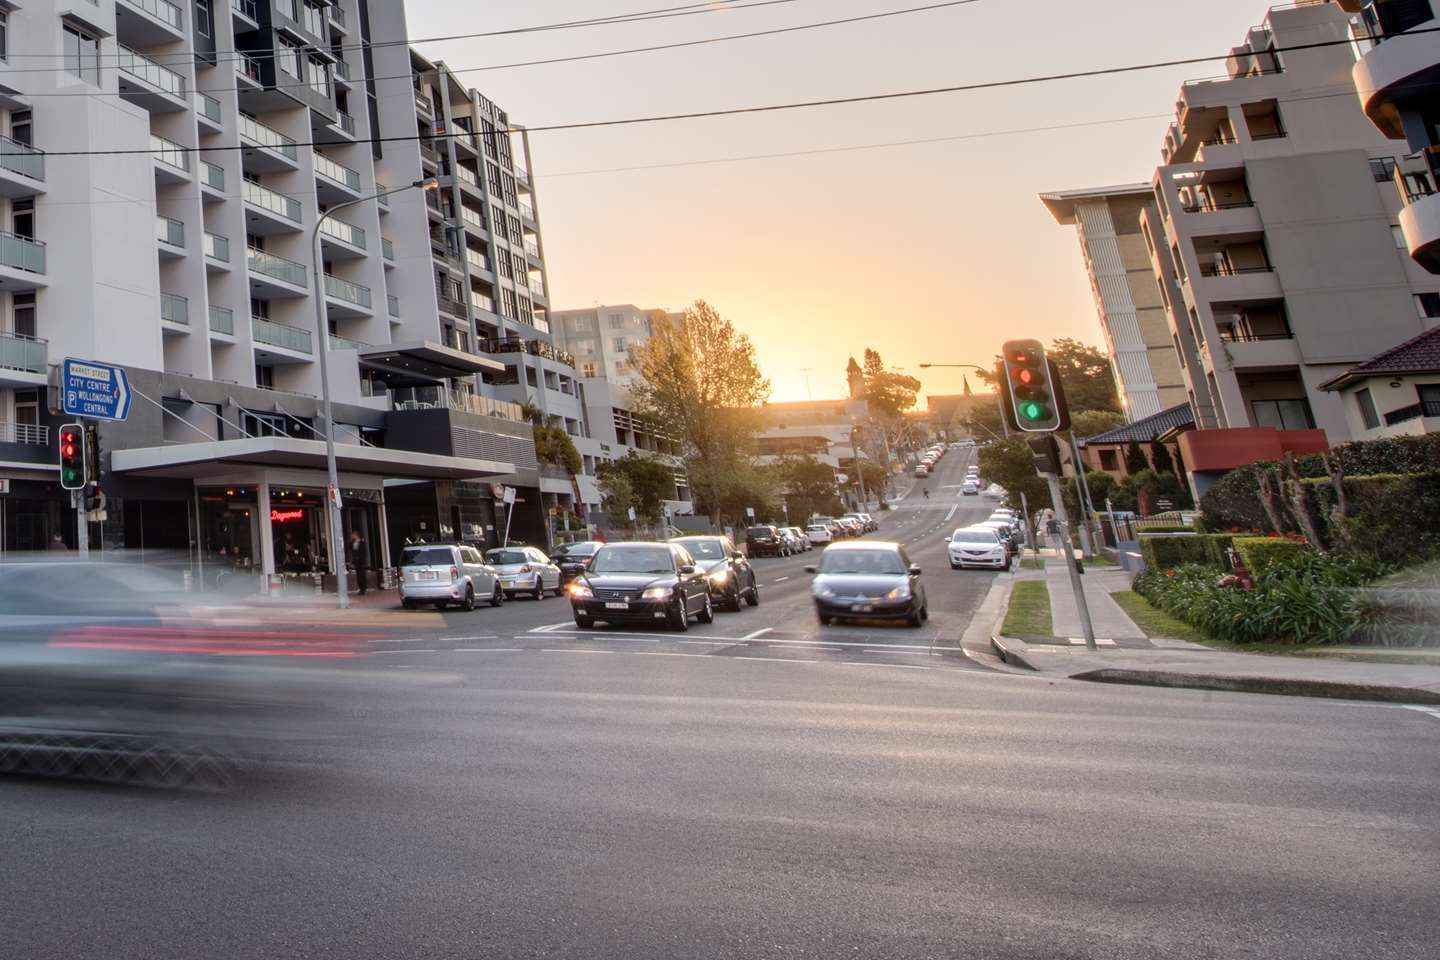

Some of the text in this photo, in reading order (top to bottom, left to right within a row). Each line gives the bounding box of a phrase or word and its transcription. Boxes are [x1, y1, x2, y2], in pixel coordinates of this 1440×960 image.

[69, 377, 111, 392] CITY CENTRE
[78, 390, 113, 404] WOLLONGONG
[83, 402, 109, 415] CENTRAL
